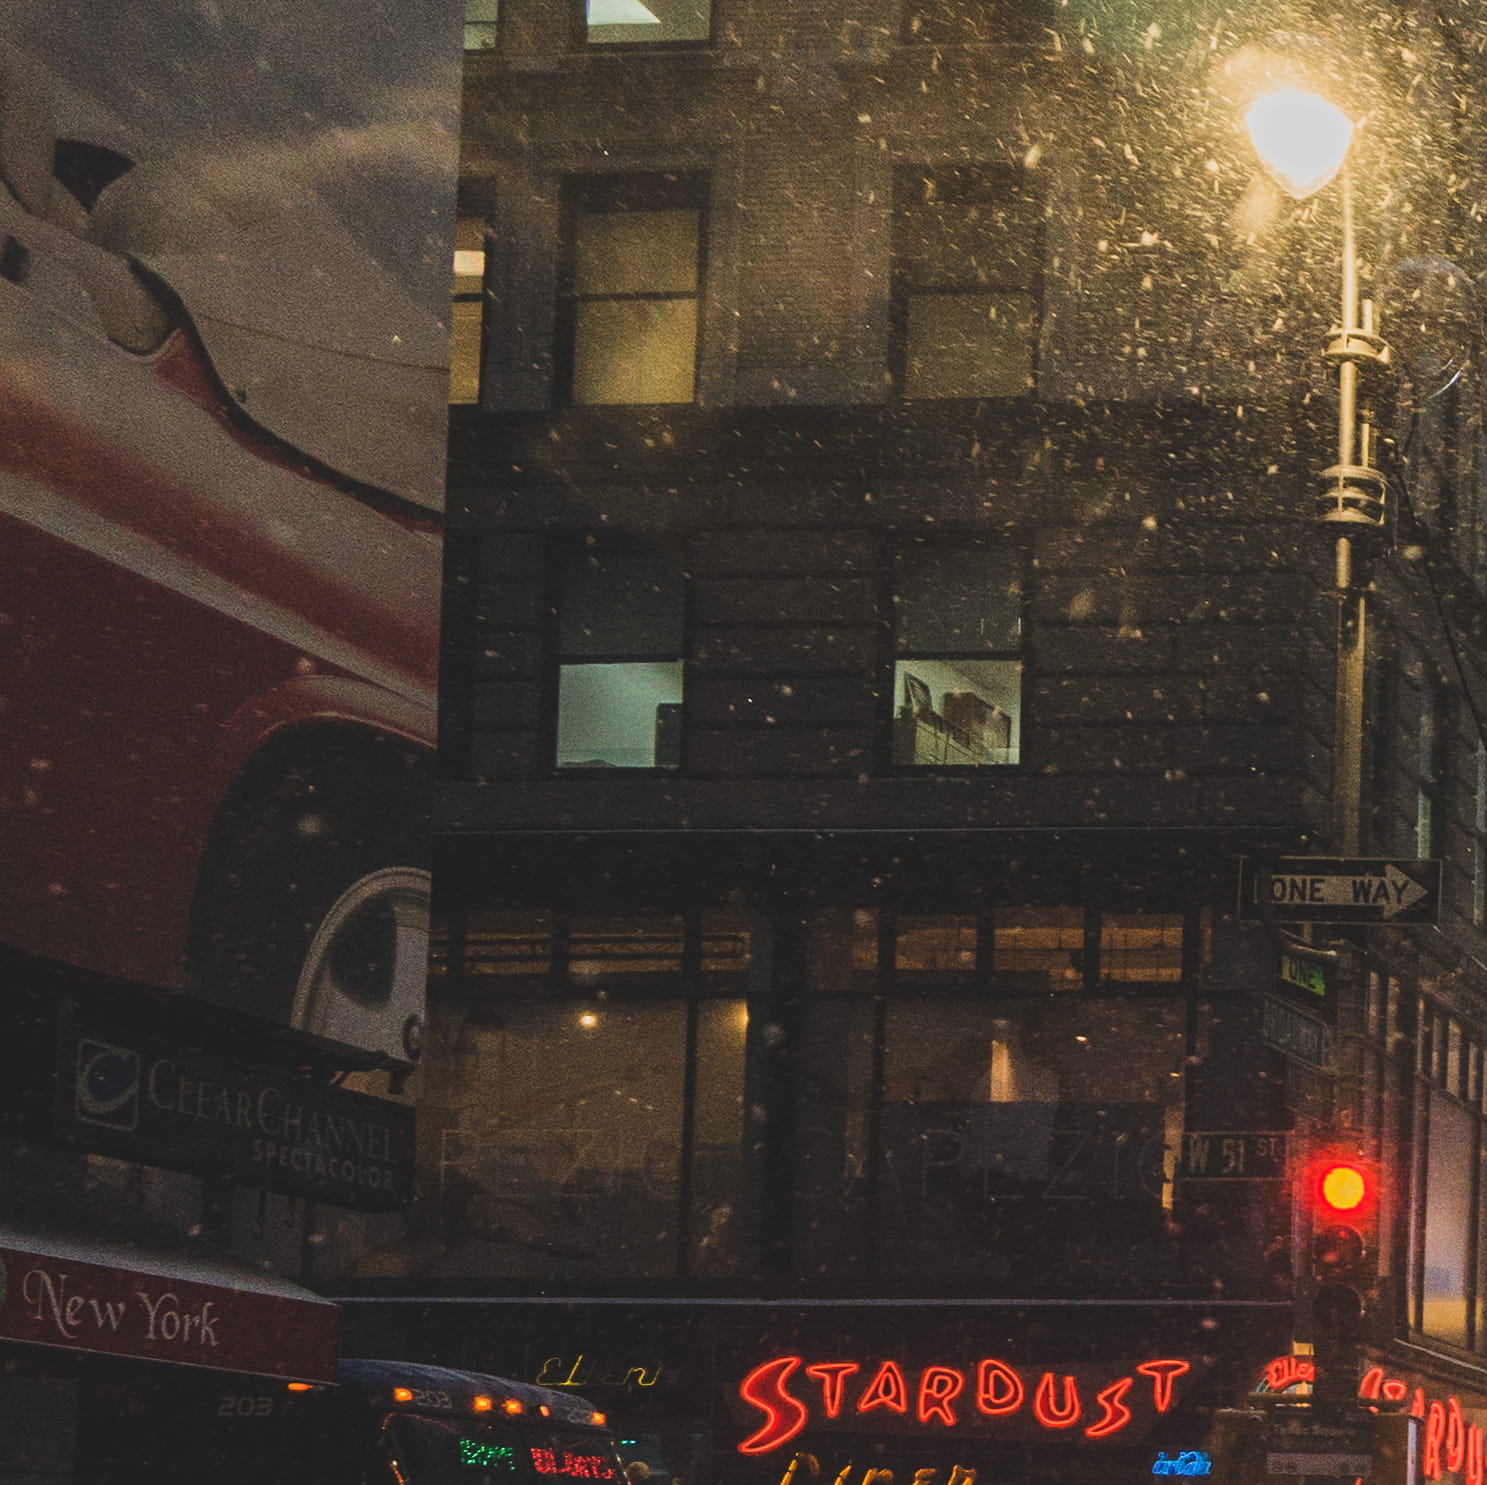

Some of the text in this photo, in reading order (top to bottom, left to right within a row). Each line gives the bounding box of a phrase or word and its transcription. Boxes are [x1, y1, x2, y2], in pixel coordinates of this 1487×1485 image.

[1272, 877, 1410, 904] ONE WAY
[253, 1137, 394, 1191] SPECTACOLOR
[1189, 1137, 1209, 1175] W
[1221, 1139, 1246, 1176] 51
[1258, 1136, 1279, 1154] ST
[23, 1268, 221, 1347] New York
[217, 1396, 273, 1417] 203
[414, 1393, 453, 1410] 203
[739, 1356, 1190, 1453] STARDUST
